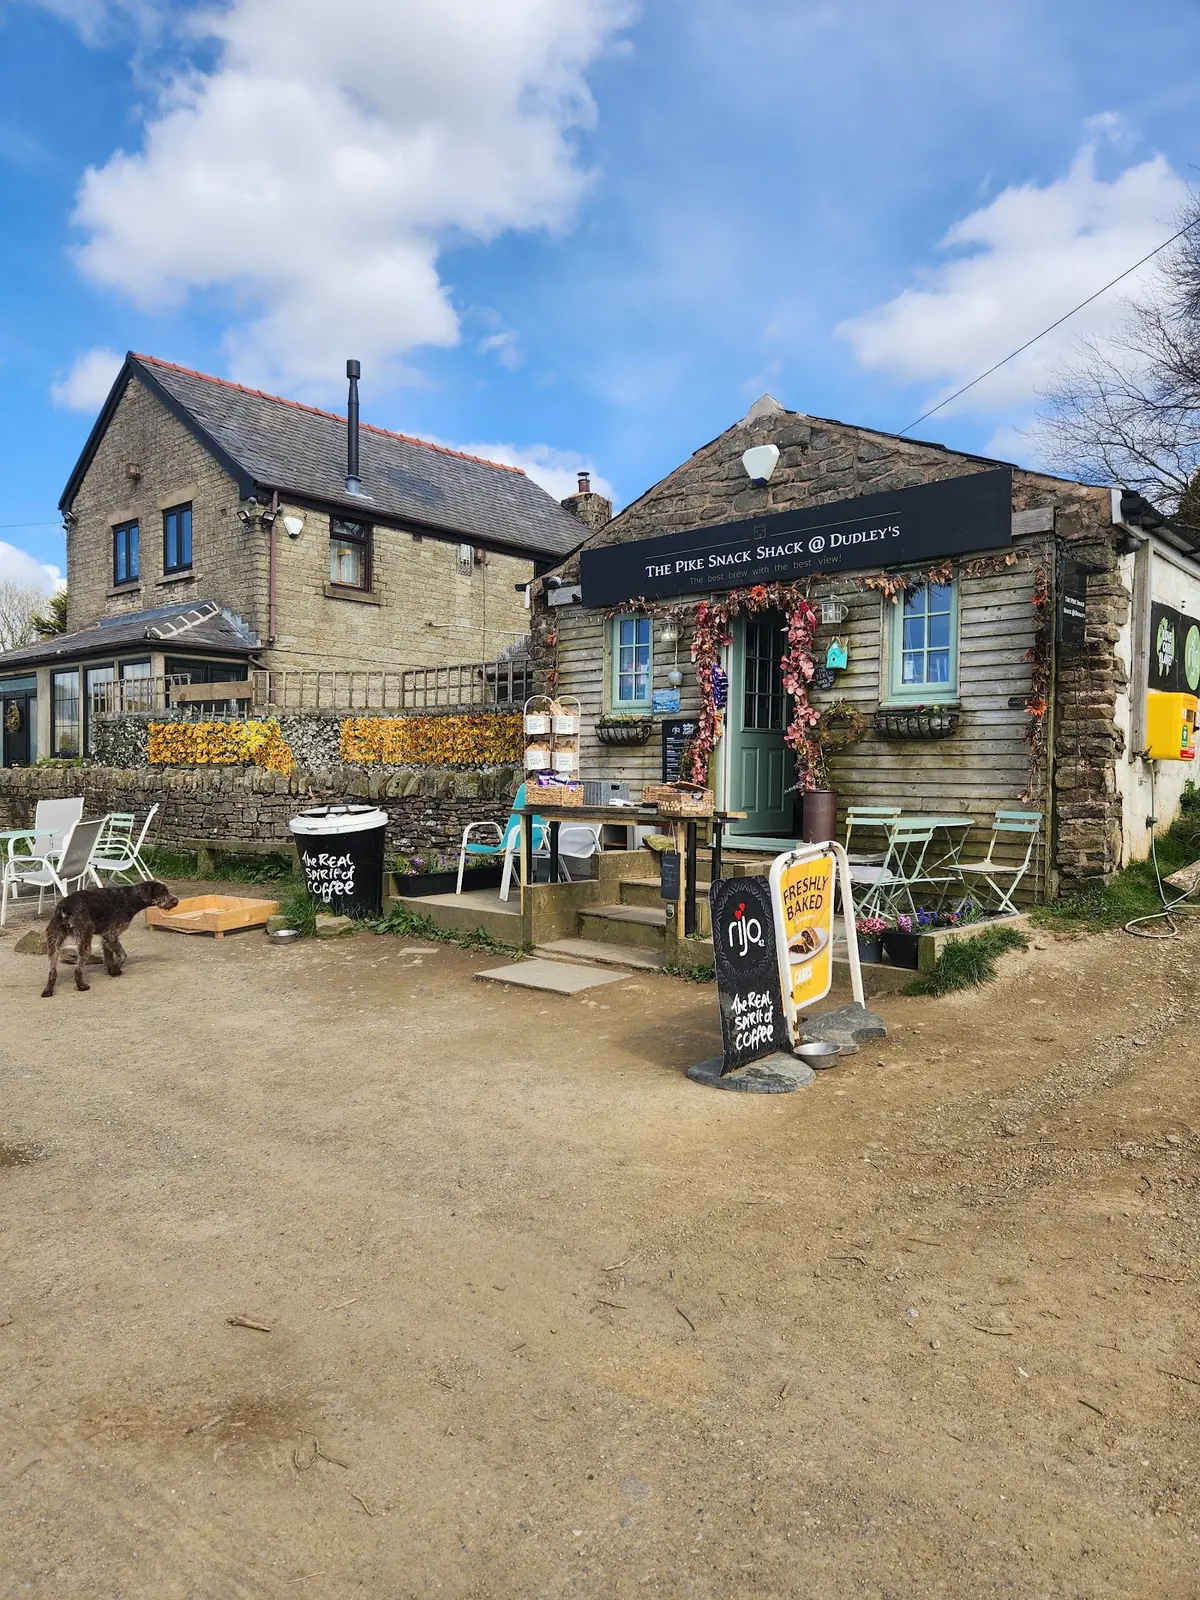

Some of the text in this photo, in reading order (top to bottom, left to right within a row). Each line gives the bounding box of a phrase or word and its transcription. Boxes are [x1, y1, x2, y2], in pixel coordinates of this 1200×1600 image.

[645, 526, 900, 578] THE PIKE SNACK SHACK @ DUDLEY'S
[689, 553, 842, 585] The best brew with the best view!
[341, 865, 356, 880] of
[782, 875, 829, 906] FRESHLY
[786, 894, 823, 921] BAKED
[764, 1005, 774, 1024] of
